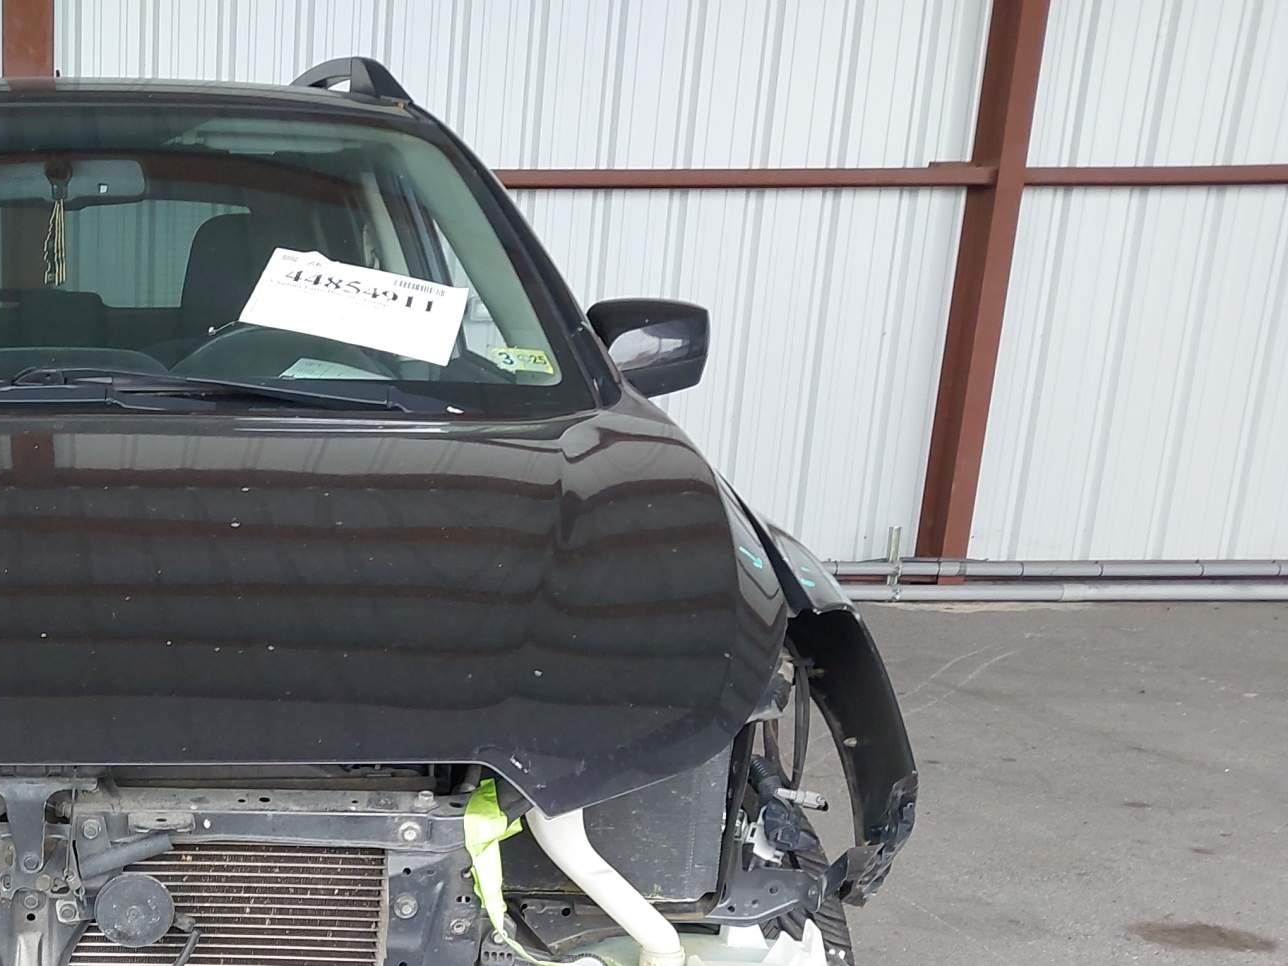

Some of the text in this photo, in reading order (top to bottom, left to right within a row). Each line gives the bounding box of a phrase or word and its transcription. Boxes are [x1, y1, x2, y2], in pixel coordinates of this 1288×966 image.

[284, 270, 433, 312] 44854911
[498, 352, 547, 365] 3 25
